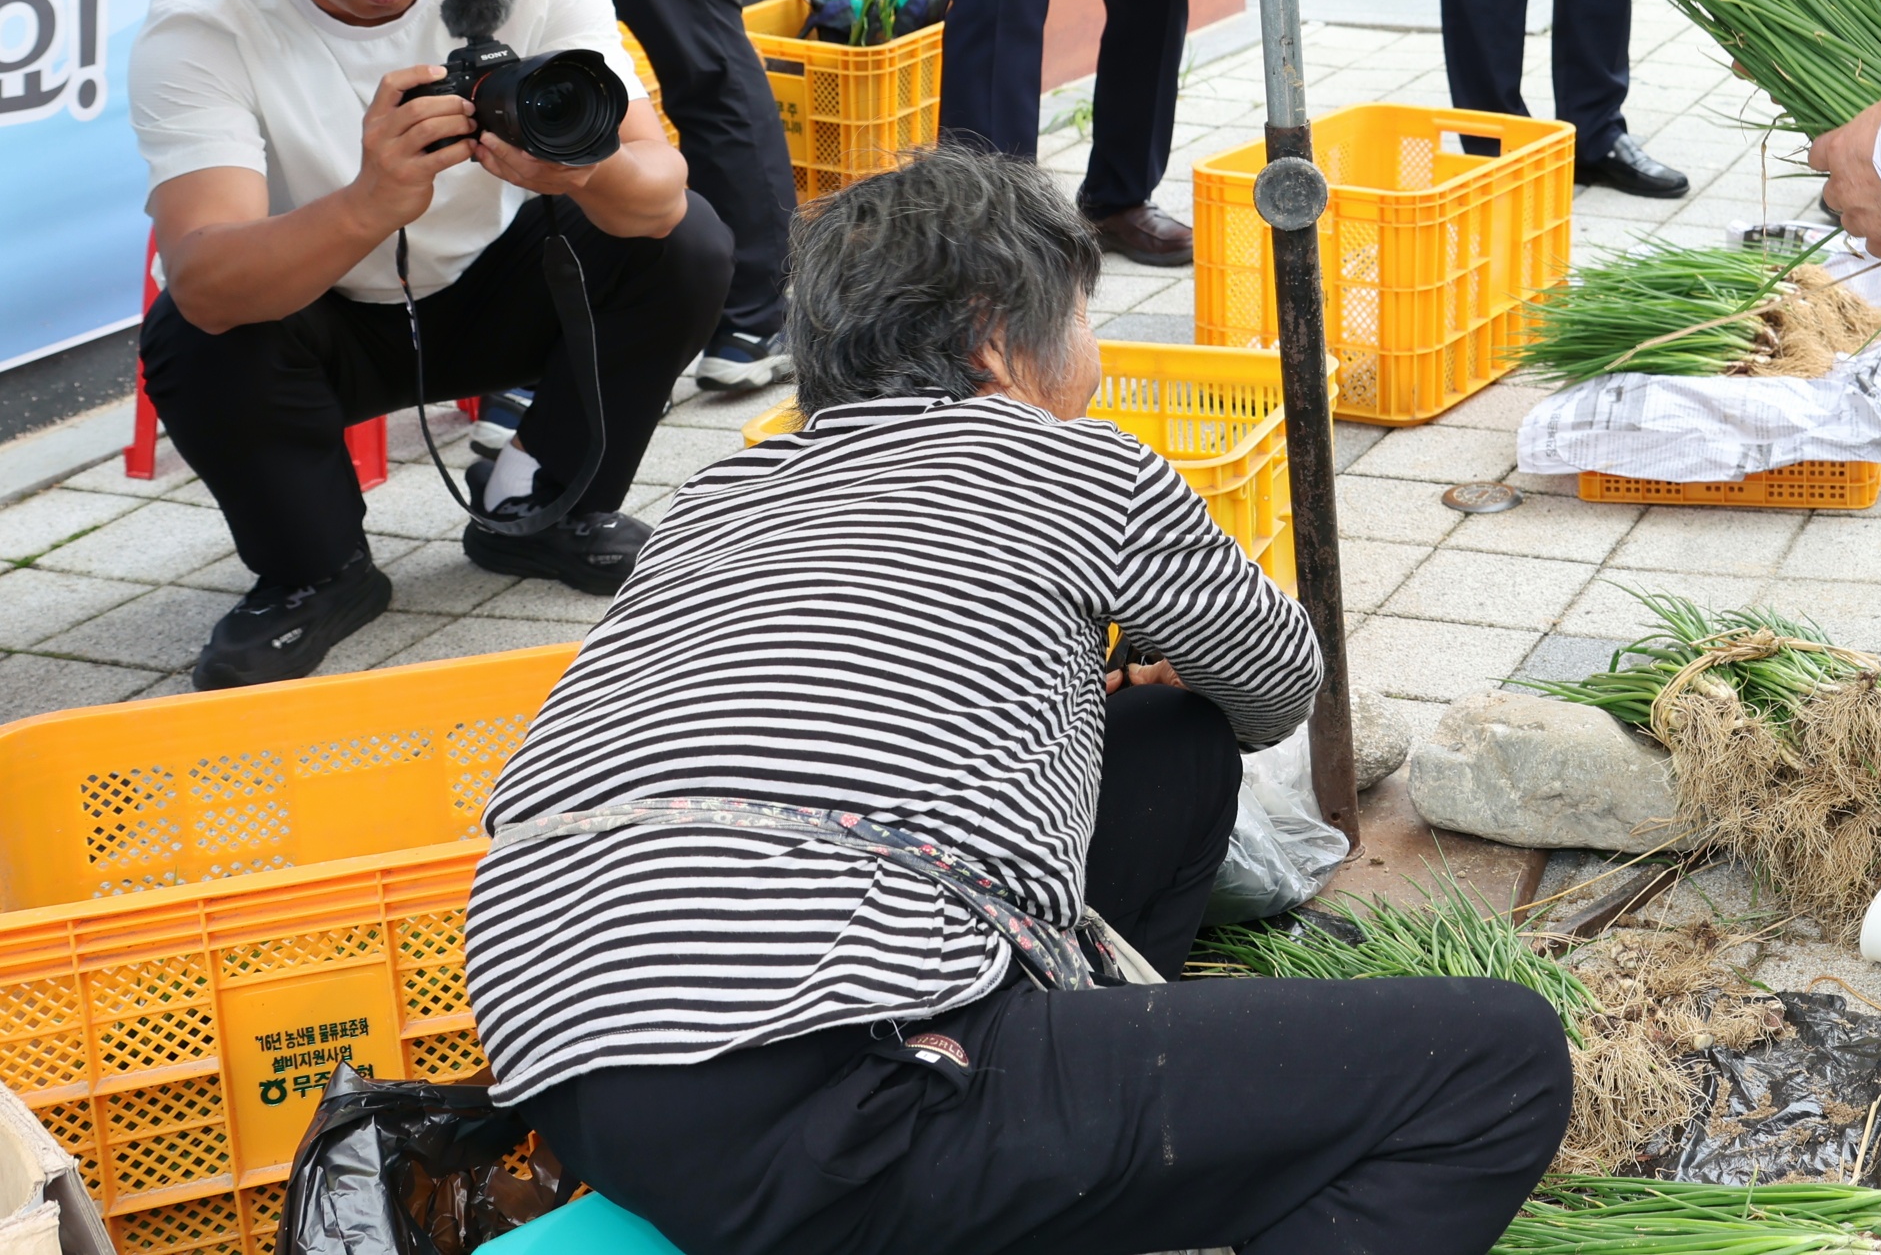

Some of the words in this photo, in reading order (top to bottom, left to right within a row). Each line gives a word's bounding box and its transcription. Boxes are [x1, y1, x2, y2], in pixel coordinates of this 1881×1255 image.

[480, 49, 509, 62] SONY
[284, 1025, 316, 1050] 농산물
[318, 1016, 369, 1044] 물류표준화
[271, 1043, 353, 1074] 설비지원사업
[916, 1036, 964, 1060] WORLD
